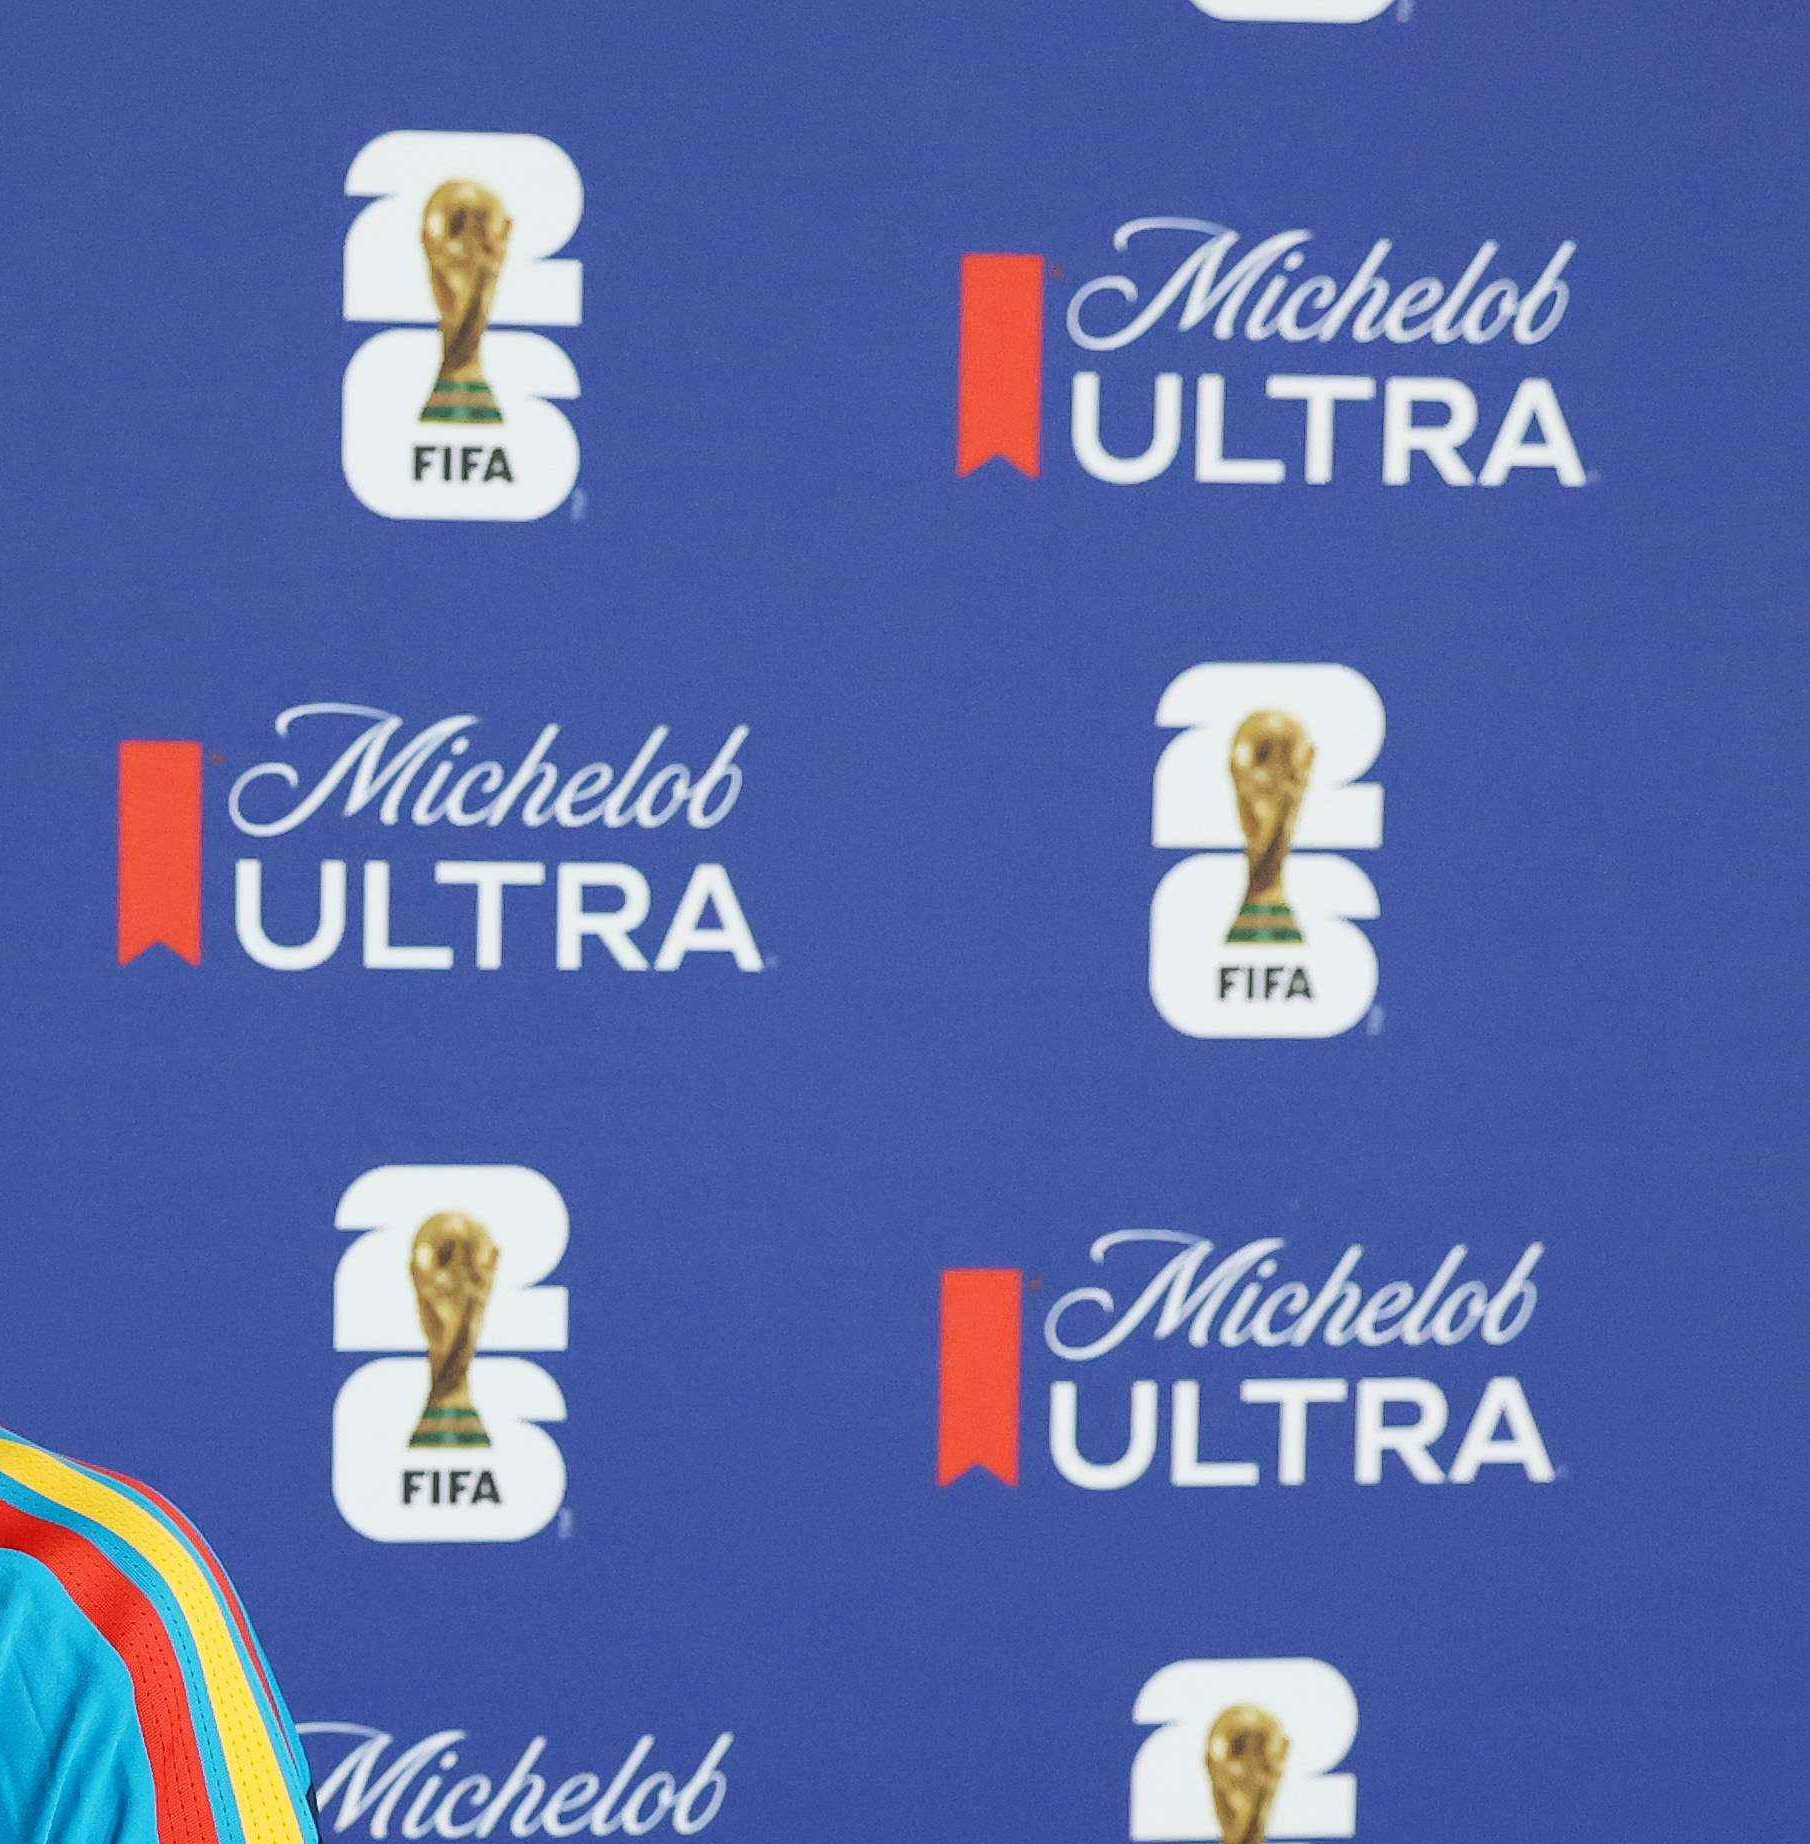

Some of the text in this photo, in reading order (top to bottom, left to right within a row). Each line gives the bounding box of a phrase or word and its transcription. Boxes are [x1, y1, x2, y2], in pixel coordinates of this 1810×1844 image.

[1065, 216, 1578, 352] Michelob
[412, 444, 514, 484] FIFA
[1070, 370, 1588, 488] ULTRA
[227, 701, 750, 838] Michelob
[234, 857, 766, 974] ULTRA
[1218, 965, 1313, 1000] FIFA
[1043, 1228, 1545, 1362] Michelob
[401, 1469, 502, 1506] FIFA
[1048, 1375, 1557, 1491] ULTRA
